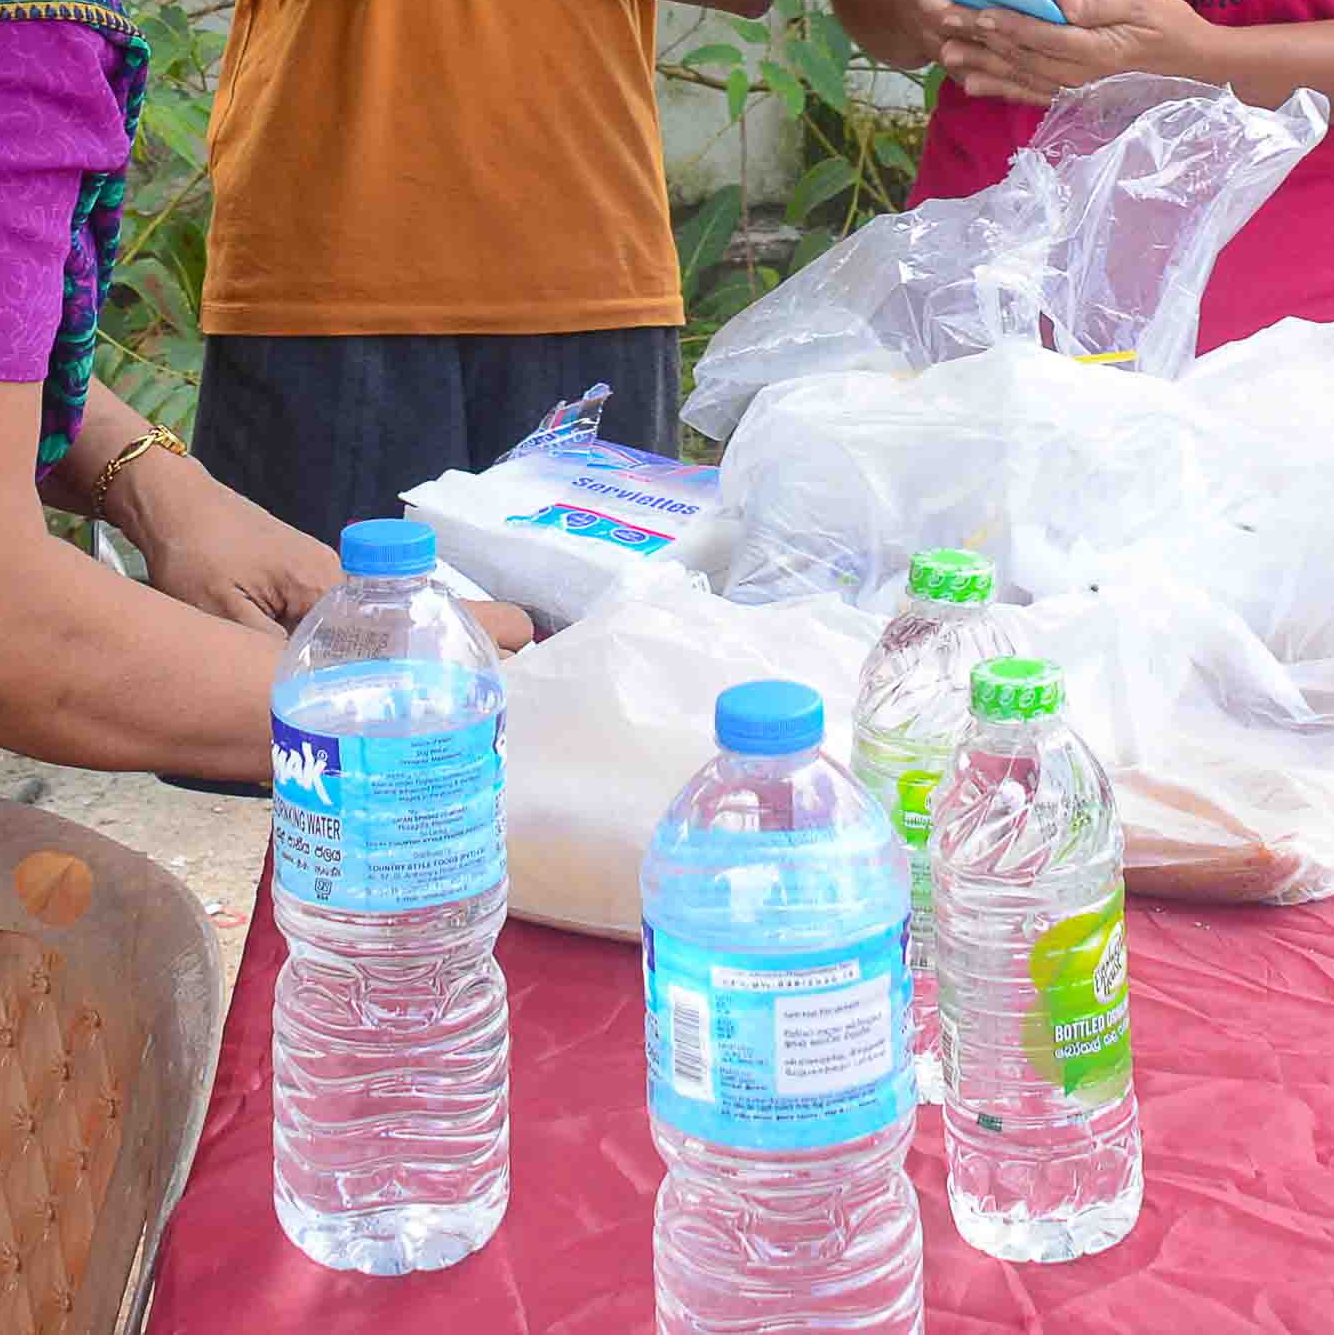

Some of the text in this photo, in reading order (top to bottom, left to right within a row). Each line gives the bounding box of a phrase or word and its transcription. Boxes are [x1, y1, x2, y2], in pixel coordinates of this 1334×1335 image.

[571, 475, 701, 517] Serviettes
[271, 739, 332, 806] mak
[307, 812, 341, 841] WATER
[1054, 1015, 1105, 1043] BOTTLED
